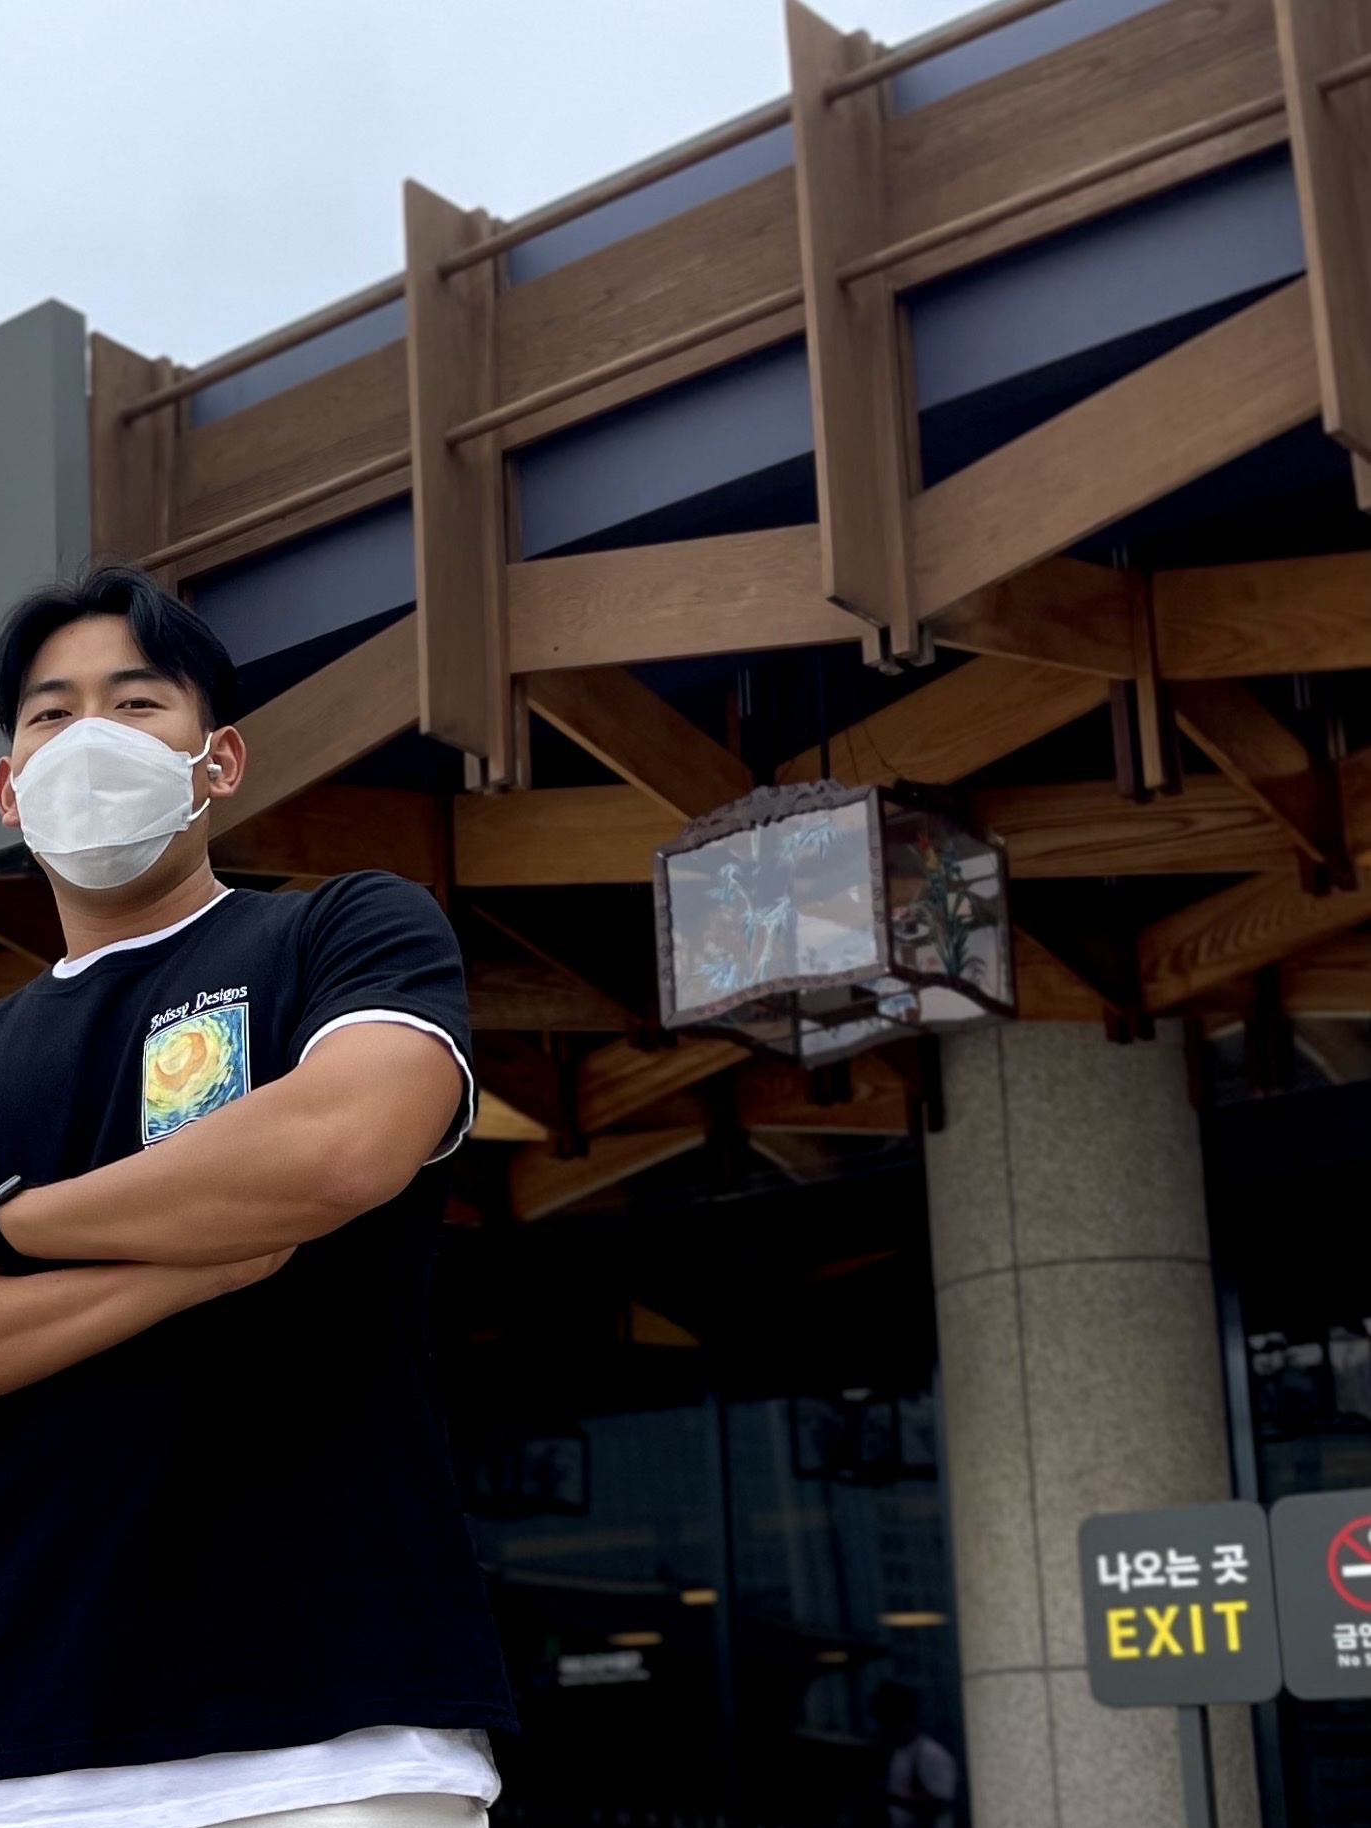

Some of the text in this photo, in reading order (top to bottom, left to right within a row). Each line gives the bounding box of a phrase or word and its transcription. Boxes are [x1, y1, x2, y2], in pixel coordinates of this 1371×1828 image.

[191, 986, 248, 1014] Designs
[1097, 1544, 1249, 1593] 나오는 곳
[1106, 1600, 1249, 1660] EXIT
[1337, 1653, 1361, 1668] No
